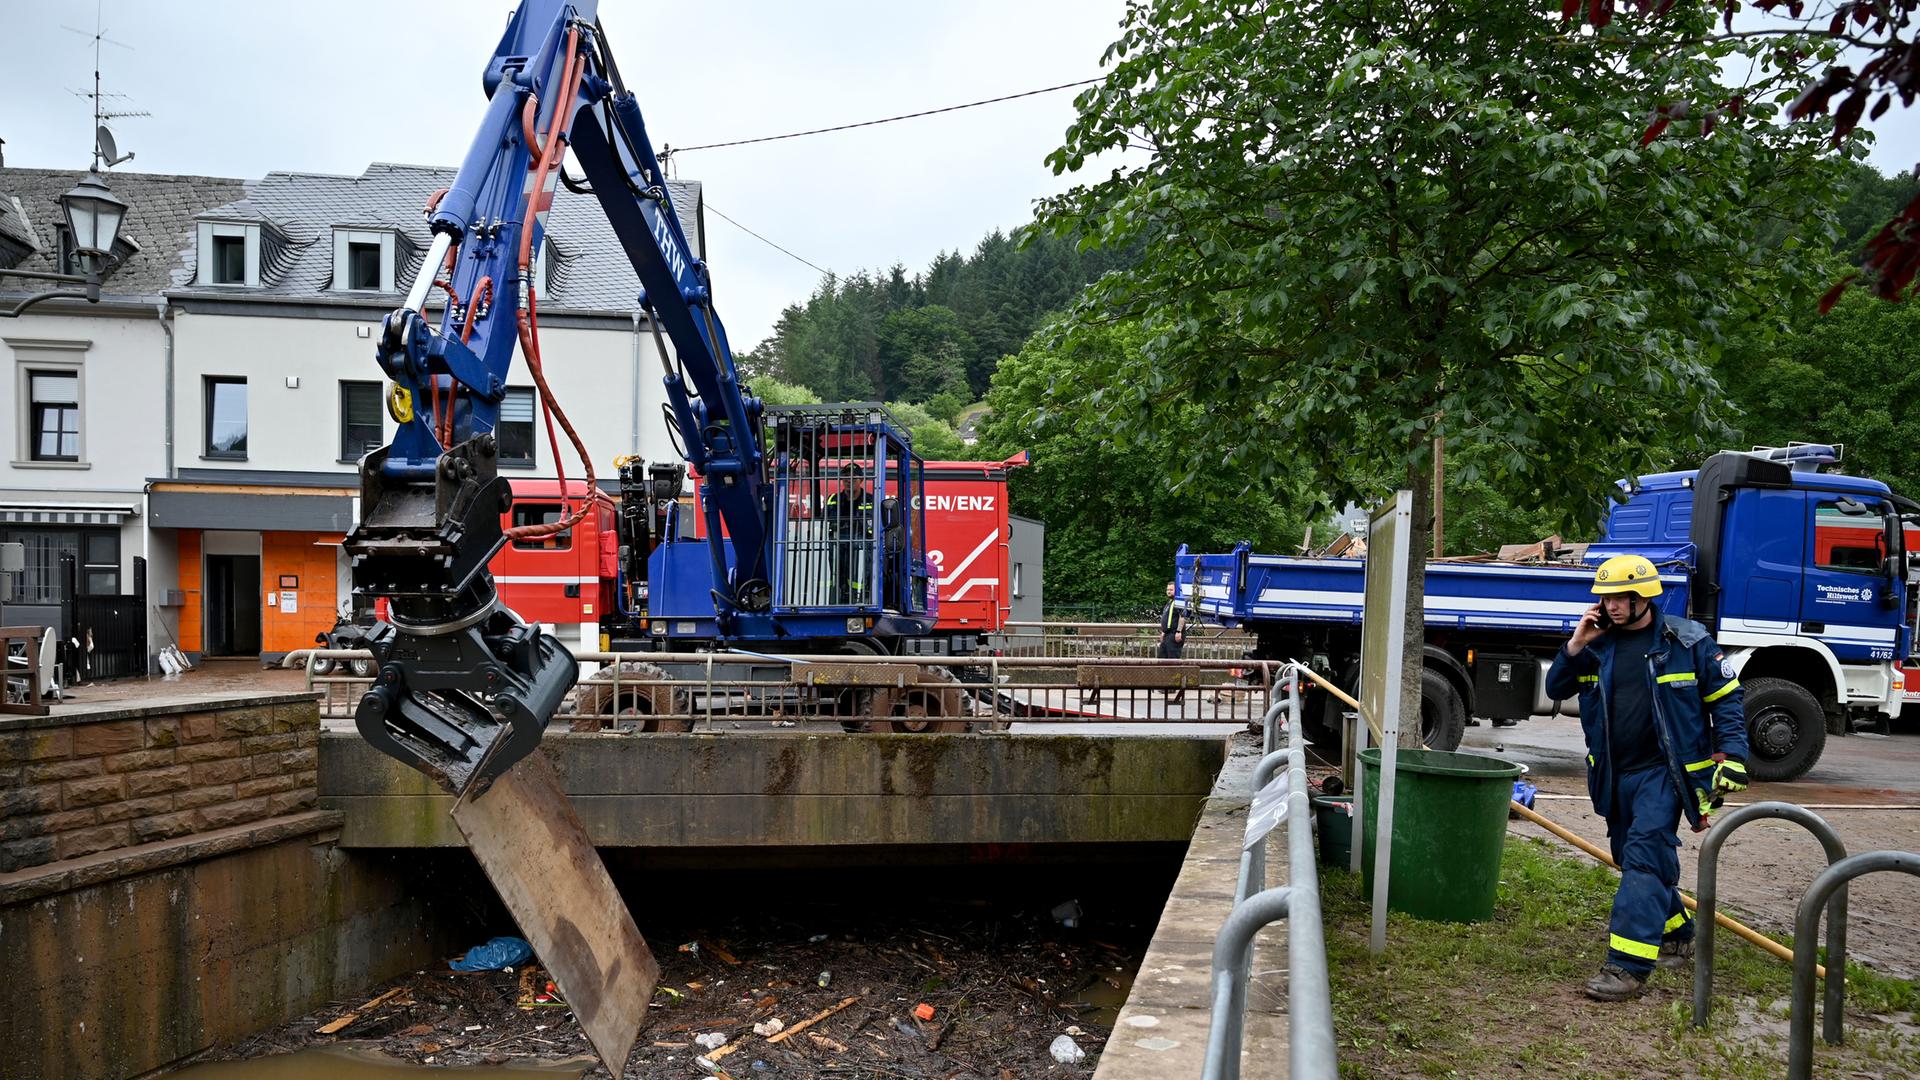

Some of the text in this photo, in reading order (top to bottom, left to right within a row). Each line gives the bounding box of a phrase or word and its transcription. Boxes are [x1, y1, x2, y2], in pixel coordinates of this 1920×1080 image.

[653, 206, 685, 282] THW
[1816, 584, 1859, 594] Technisches
[1826, 592, 1859, 601] Hilfswerk
[1870, 650, 1893, 659] 41/62
